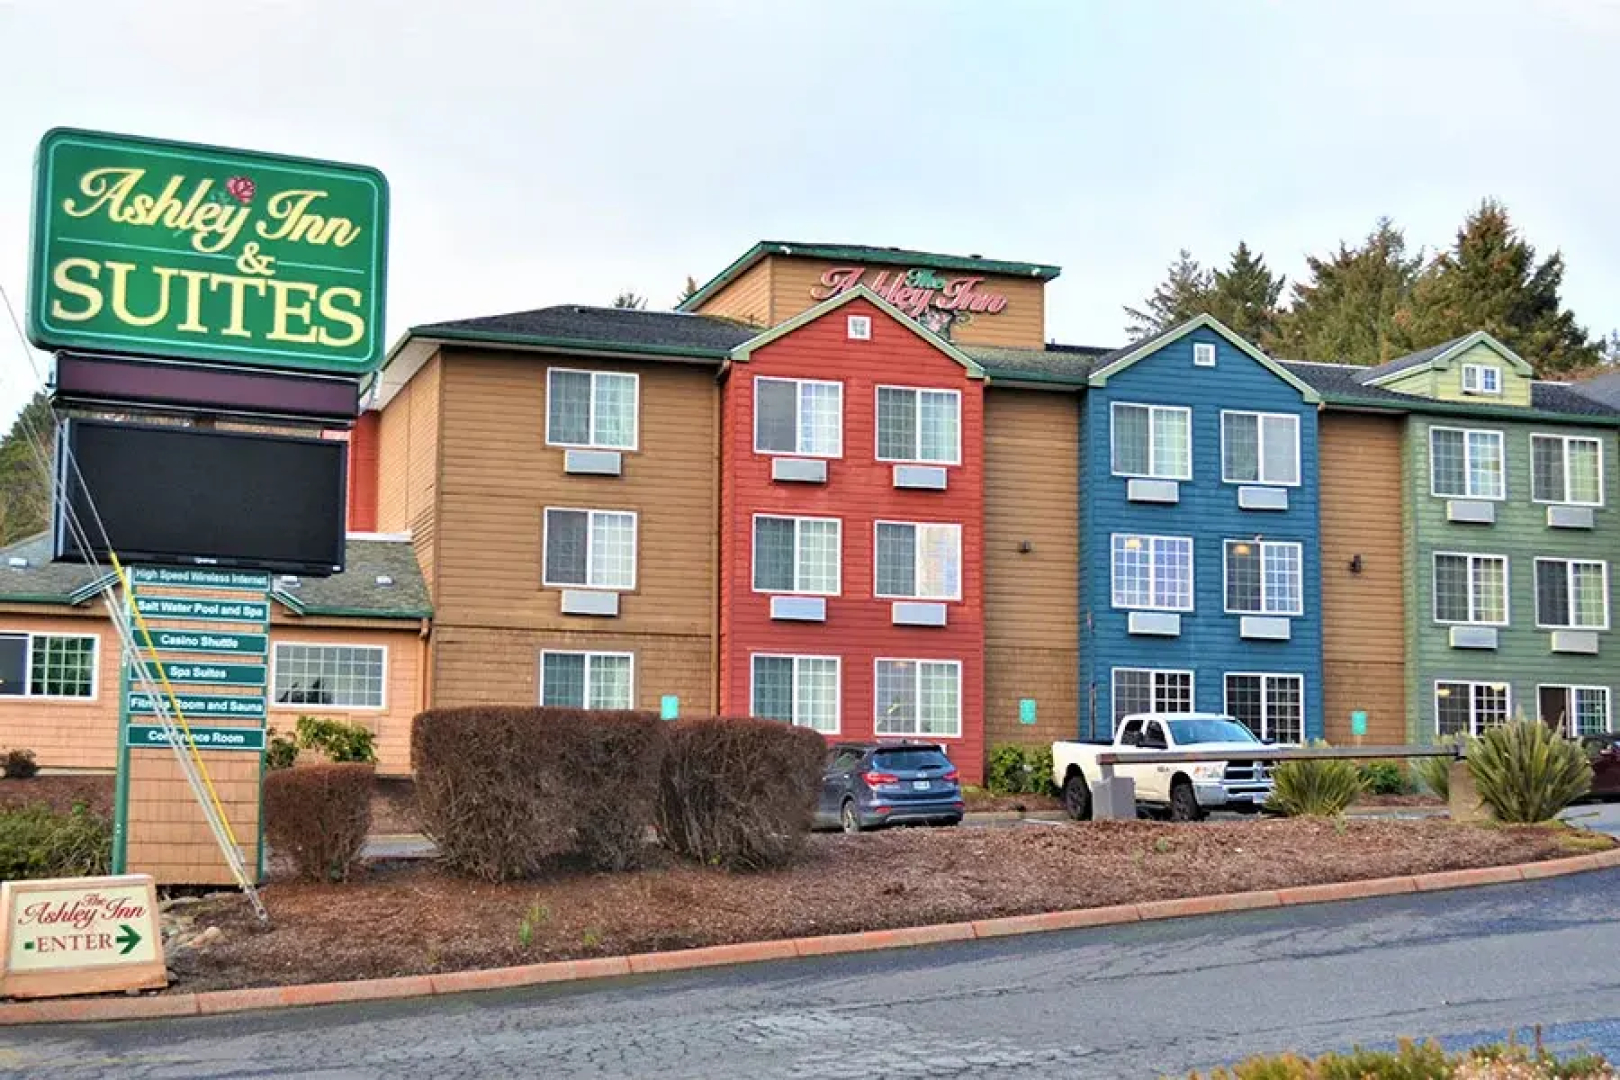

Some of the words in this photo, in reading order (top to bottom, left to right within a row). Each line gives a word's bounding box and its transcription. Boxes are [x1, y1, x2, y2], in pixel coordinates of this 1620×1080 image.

[62, 166, 252, 253] Ashley
[255, 189, 361, 247] Inn
[236, 241, 277, 275] &
[809, 267, 935, 318] Ahley
[936, 276, 1008, 315] Inn
[51, 257, 366, 347] SUITES
[136, 569, 158, 580] High
[160, 569, 190, 581] Speed
[191, 571, 230, 583] Wireless
[232, 573, 267, 584] Internet
[138, 600, 159, 611] Salt
[161, 602, 192, 612] Water
[194, 603, 218, 614] Pool
[221, 604, 241, 615] and
[243, 606, 263, 617] Spa
[161, 635, 199, 646] Casino
[201, 636, 239, 648] Shuttle
[170, 666, 190, 678] Spa
[192, 667, 226, 678] Suites
[207, 700, 228, 710] and
[230, 701, 262, 712] Sauna
[212, 732, 245, 743] Room
[18, 901, 98, 929] Ashley
[101, 898, 145, 920] Inn
[36, 933, 113, 953] ENTER
